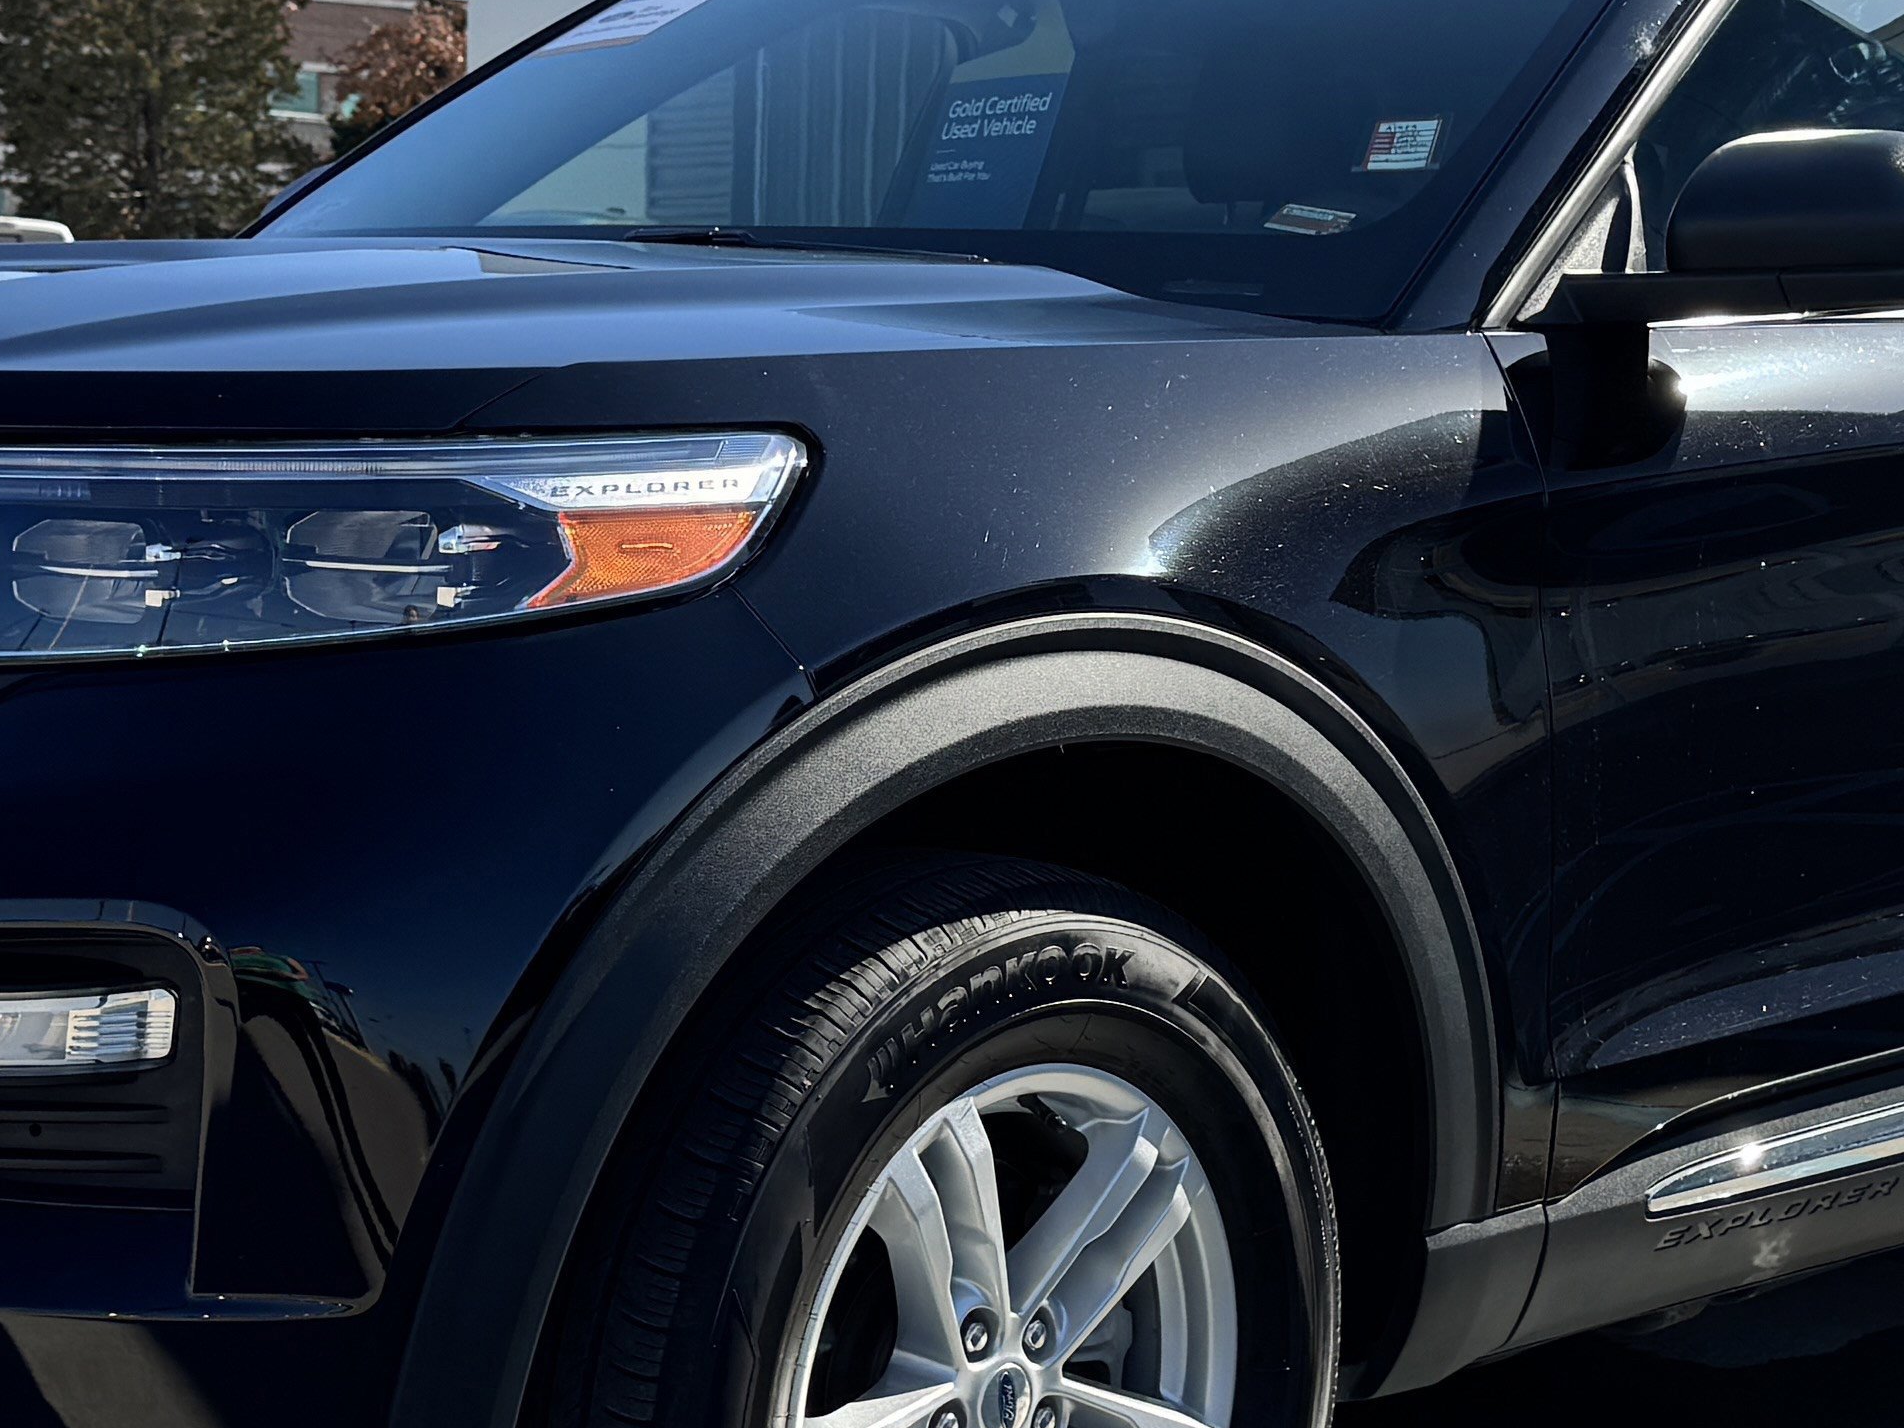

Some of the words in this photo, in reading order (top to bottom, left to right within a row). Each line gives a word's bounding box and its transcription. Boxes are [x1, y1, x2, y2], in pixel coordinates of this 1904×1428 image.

[948, 97, 985, 118] Gold
[985, 92, 1053, 115] Certified
[941, 119, 981, 140] Used
[982, 115, 1037, 137] Vehicle
[549, 478, 739, 498] EXPLORER
[1652, 1176, 1901, 1253] EXPLORER
